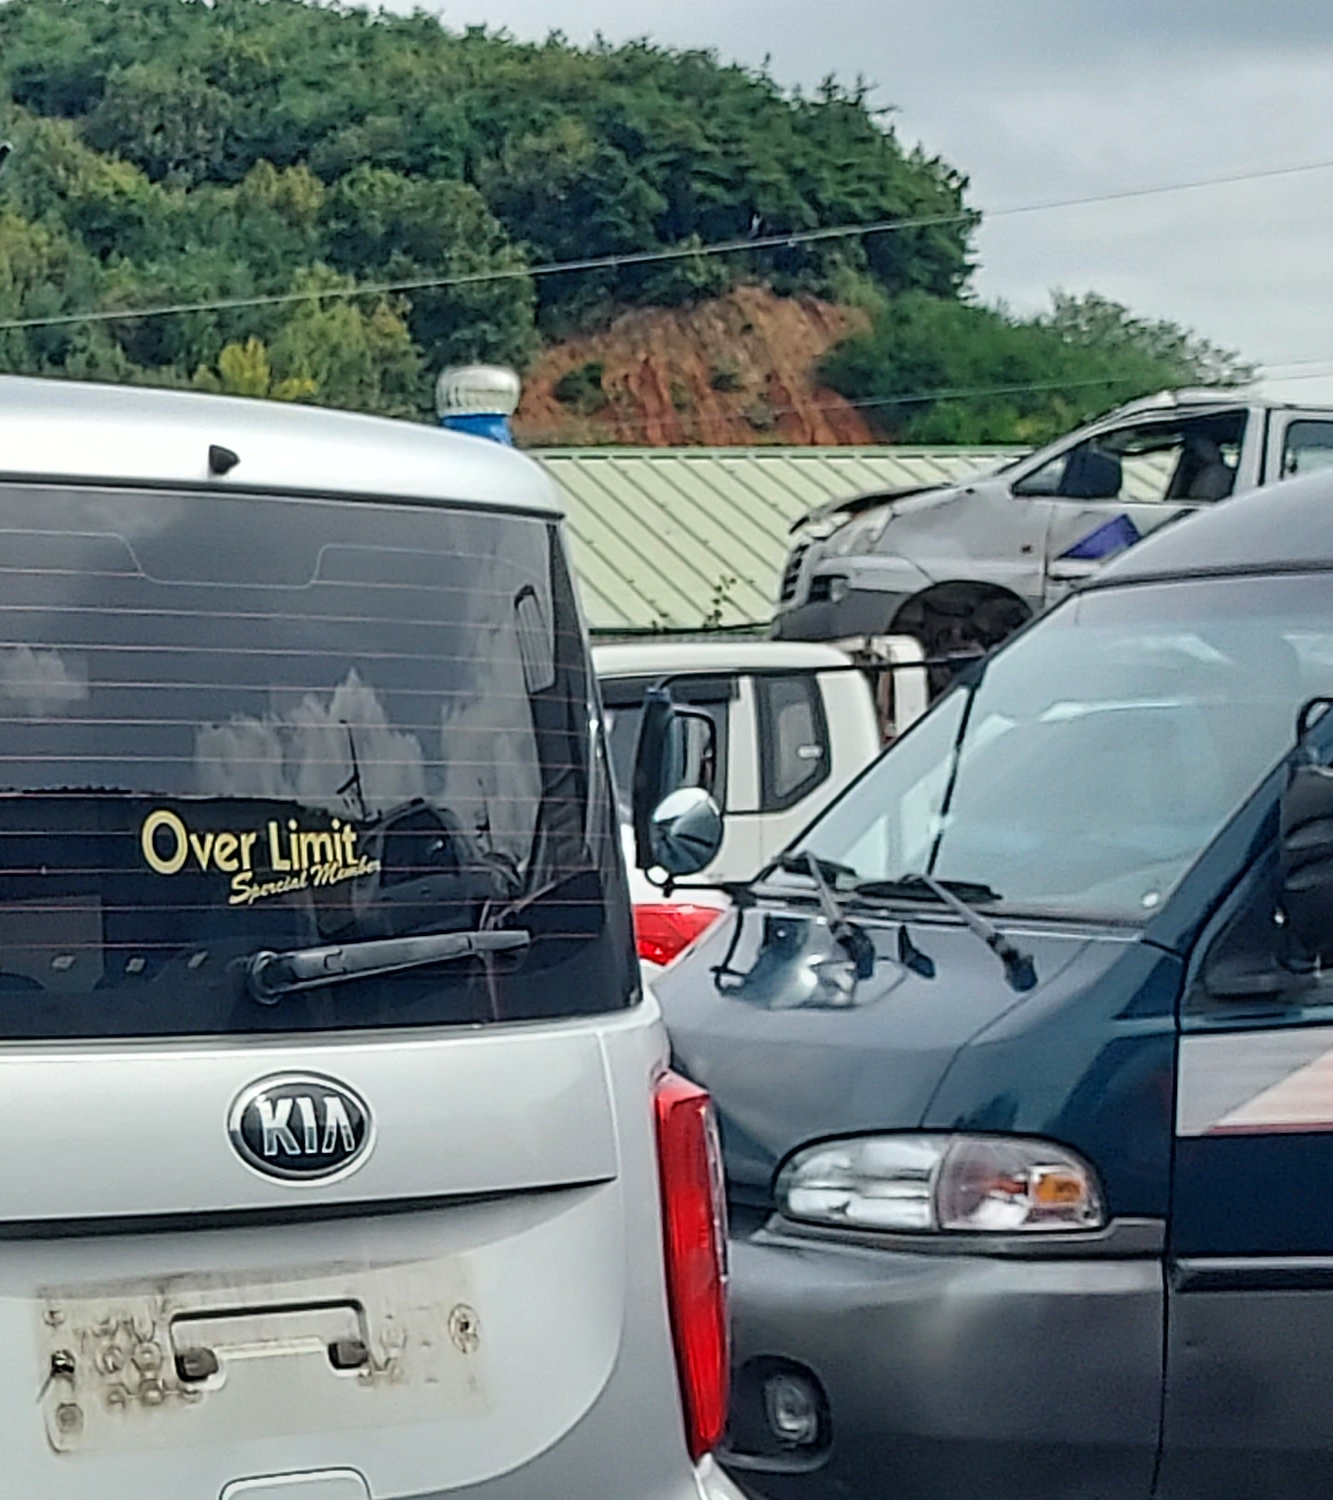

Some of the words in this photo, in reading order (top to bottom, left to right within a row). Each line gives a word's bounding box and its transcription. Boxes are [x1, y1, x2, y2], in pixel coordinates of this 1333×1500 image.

[142, 810, 257, 874] Over
[268, 819, 359, 871] Limit
[255, 1095, 355, 1156] KIA
